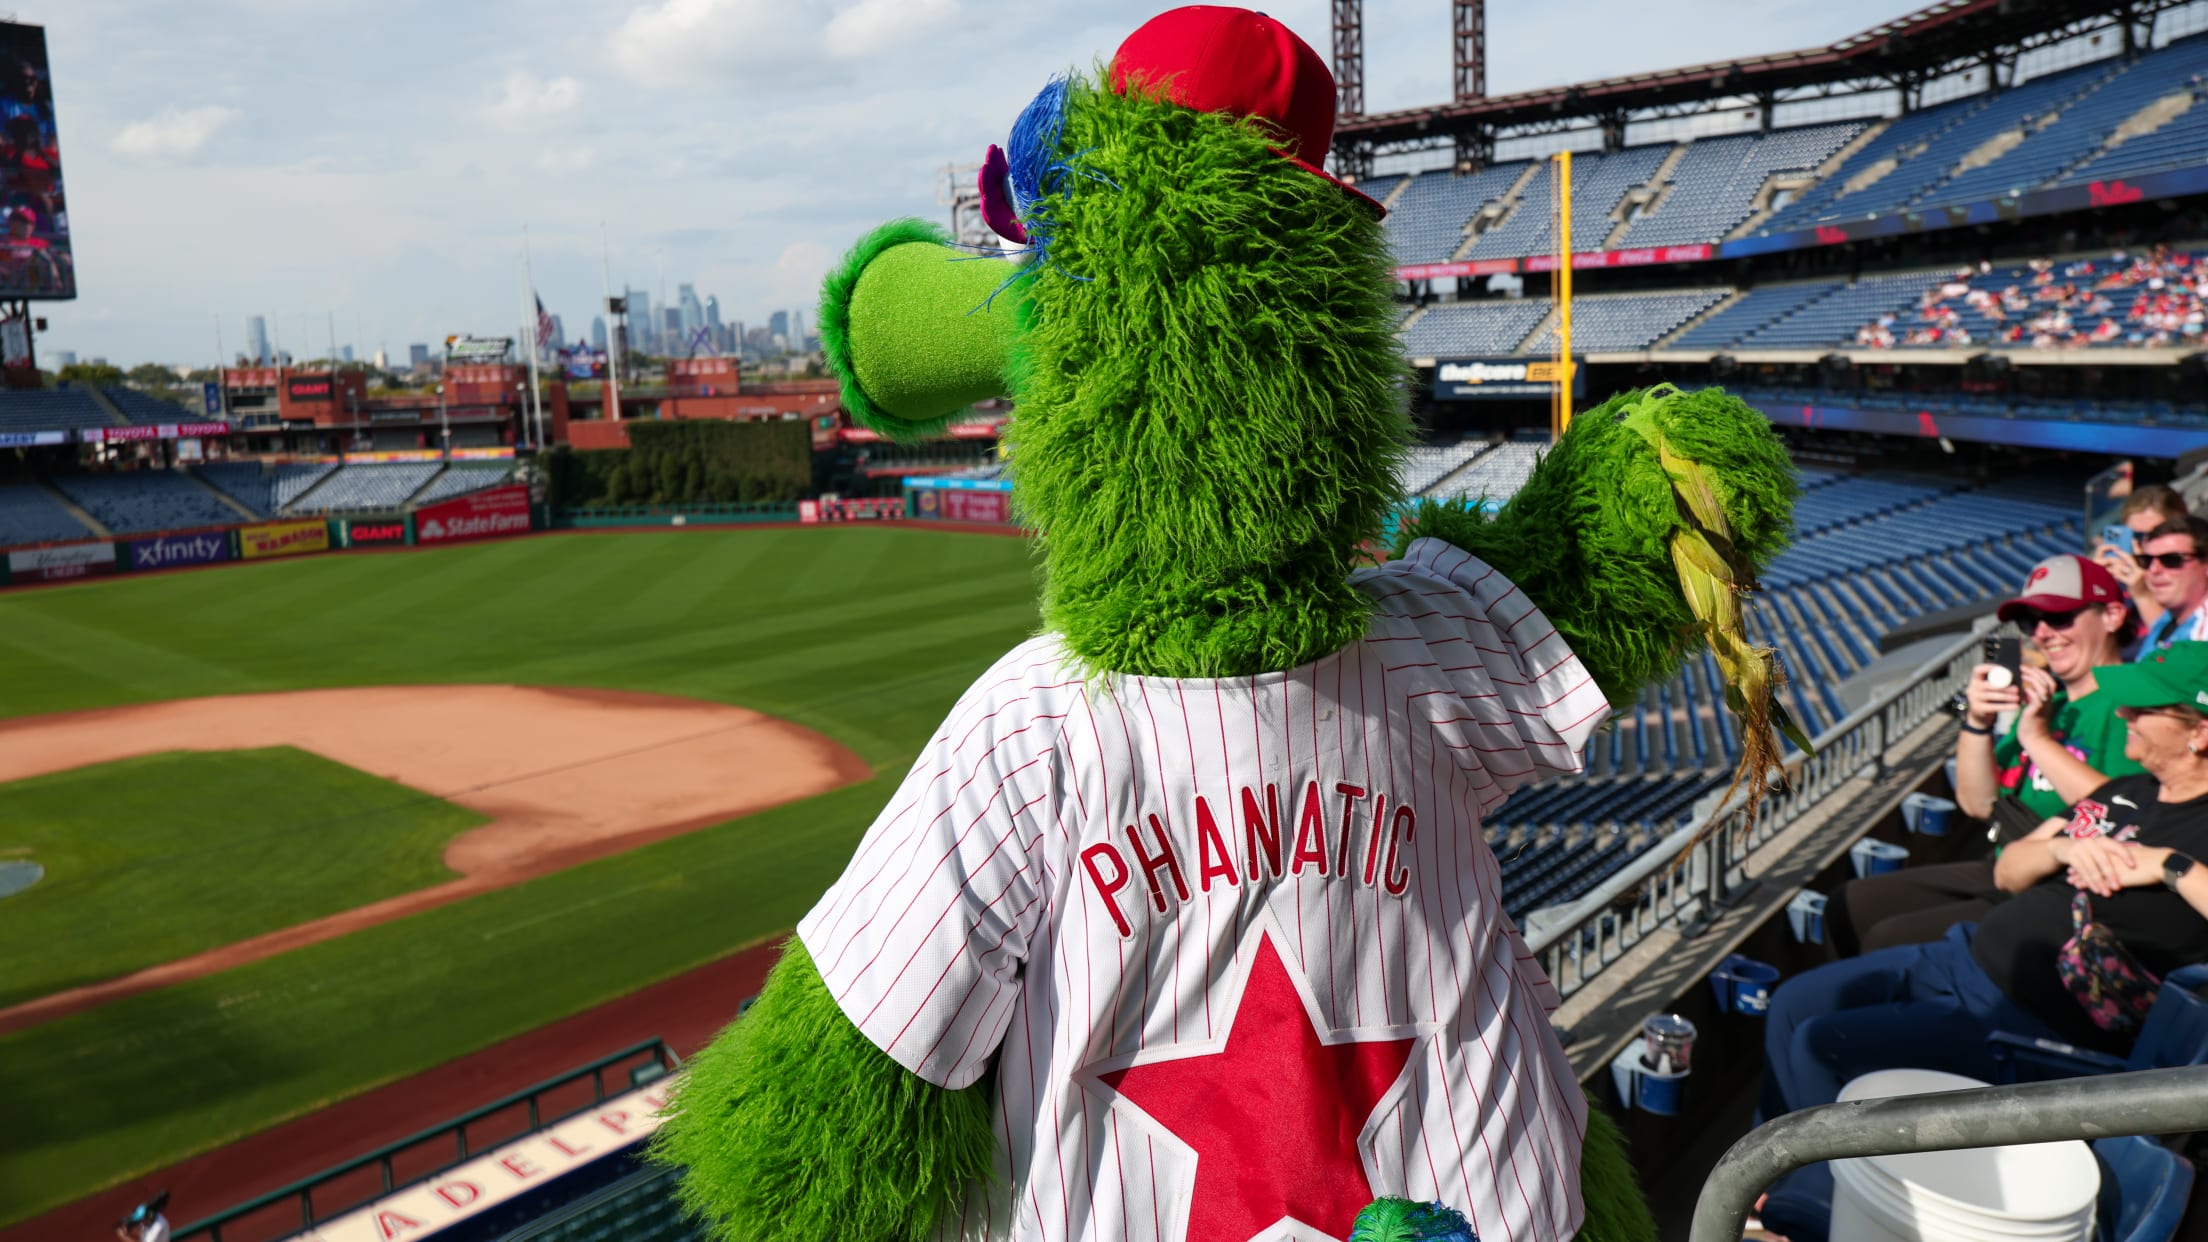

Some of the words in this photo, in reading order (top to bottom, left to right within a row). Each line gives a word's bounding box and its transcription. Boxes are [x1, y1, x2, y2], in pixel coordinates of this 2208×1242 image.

[291, 383, 330, 396] GIANT
[107, 427, 156, 440] TOYOTA
[183, 423, 227, 436] TOYOTA
[351, 524, 404, 541] GIANT
[137, 536, 222, 567] xfinity
[1080, 779, 1416, 940] PHANATIC
